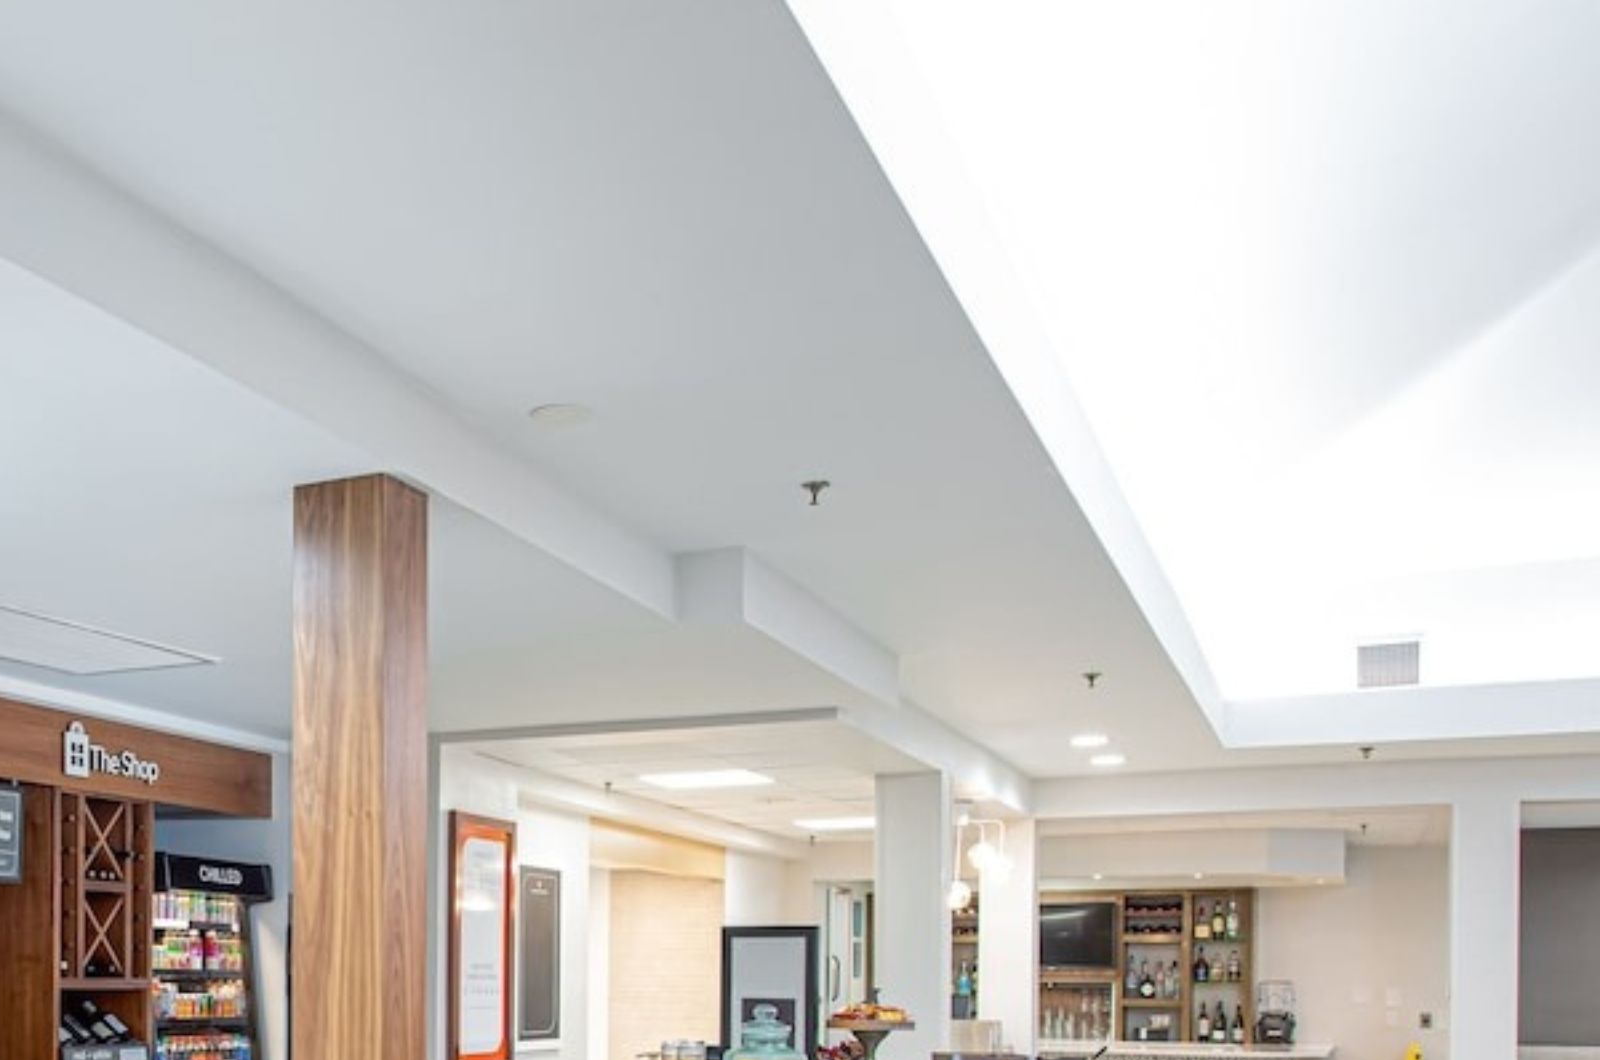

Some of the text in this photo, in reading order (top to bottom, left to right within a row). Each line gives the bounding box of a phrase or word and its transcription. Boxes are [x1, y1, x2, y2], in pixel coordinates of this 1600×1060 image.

[90, 744, 160, 785] The Shop
[199, 864, 243, 885] CHILLED
